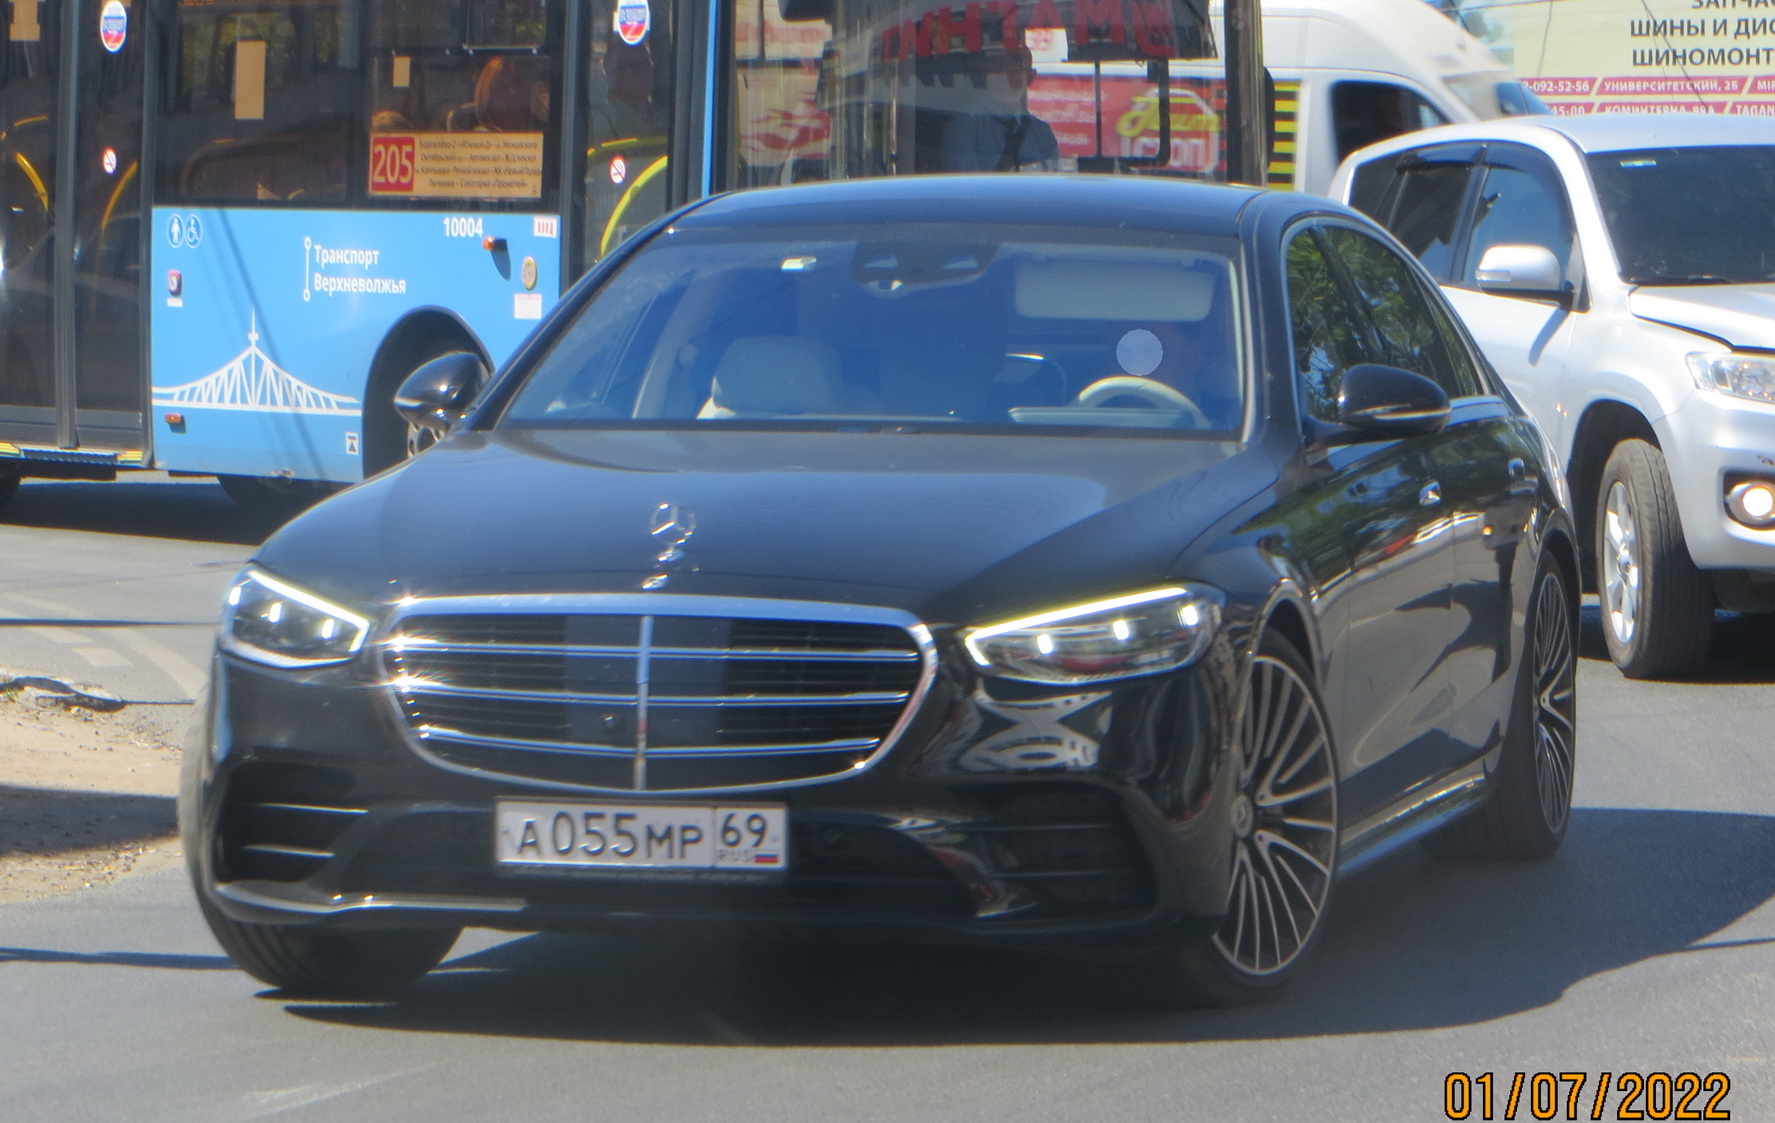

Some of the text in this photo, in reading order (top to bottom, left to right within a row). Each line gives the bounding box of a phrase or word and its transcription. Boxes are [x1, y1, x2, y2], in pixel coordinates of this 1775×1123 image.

[1691, 0, 1775, 9] ЗАПЧА
[1630, 18, 1705, 37] ШИНЫ
[1713, 18, 1728, 36] И
[1632, 47, 1775, 67] ШИНОМОНТ
[373, 144, 413, 185] 205
[443, 217, 484, 238] 10004
[314, 245, 380, 270] Транспорт
[314, 272, 406, 297] Верхневолжья
[518, 810, 768, 860] А055МР 69
